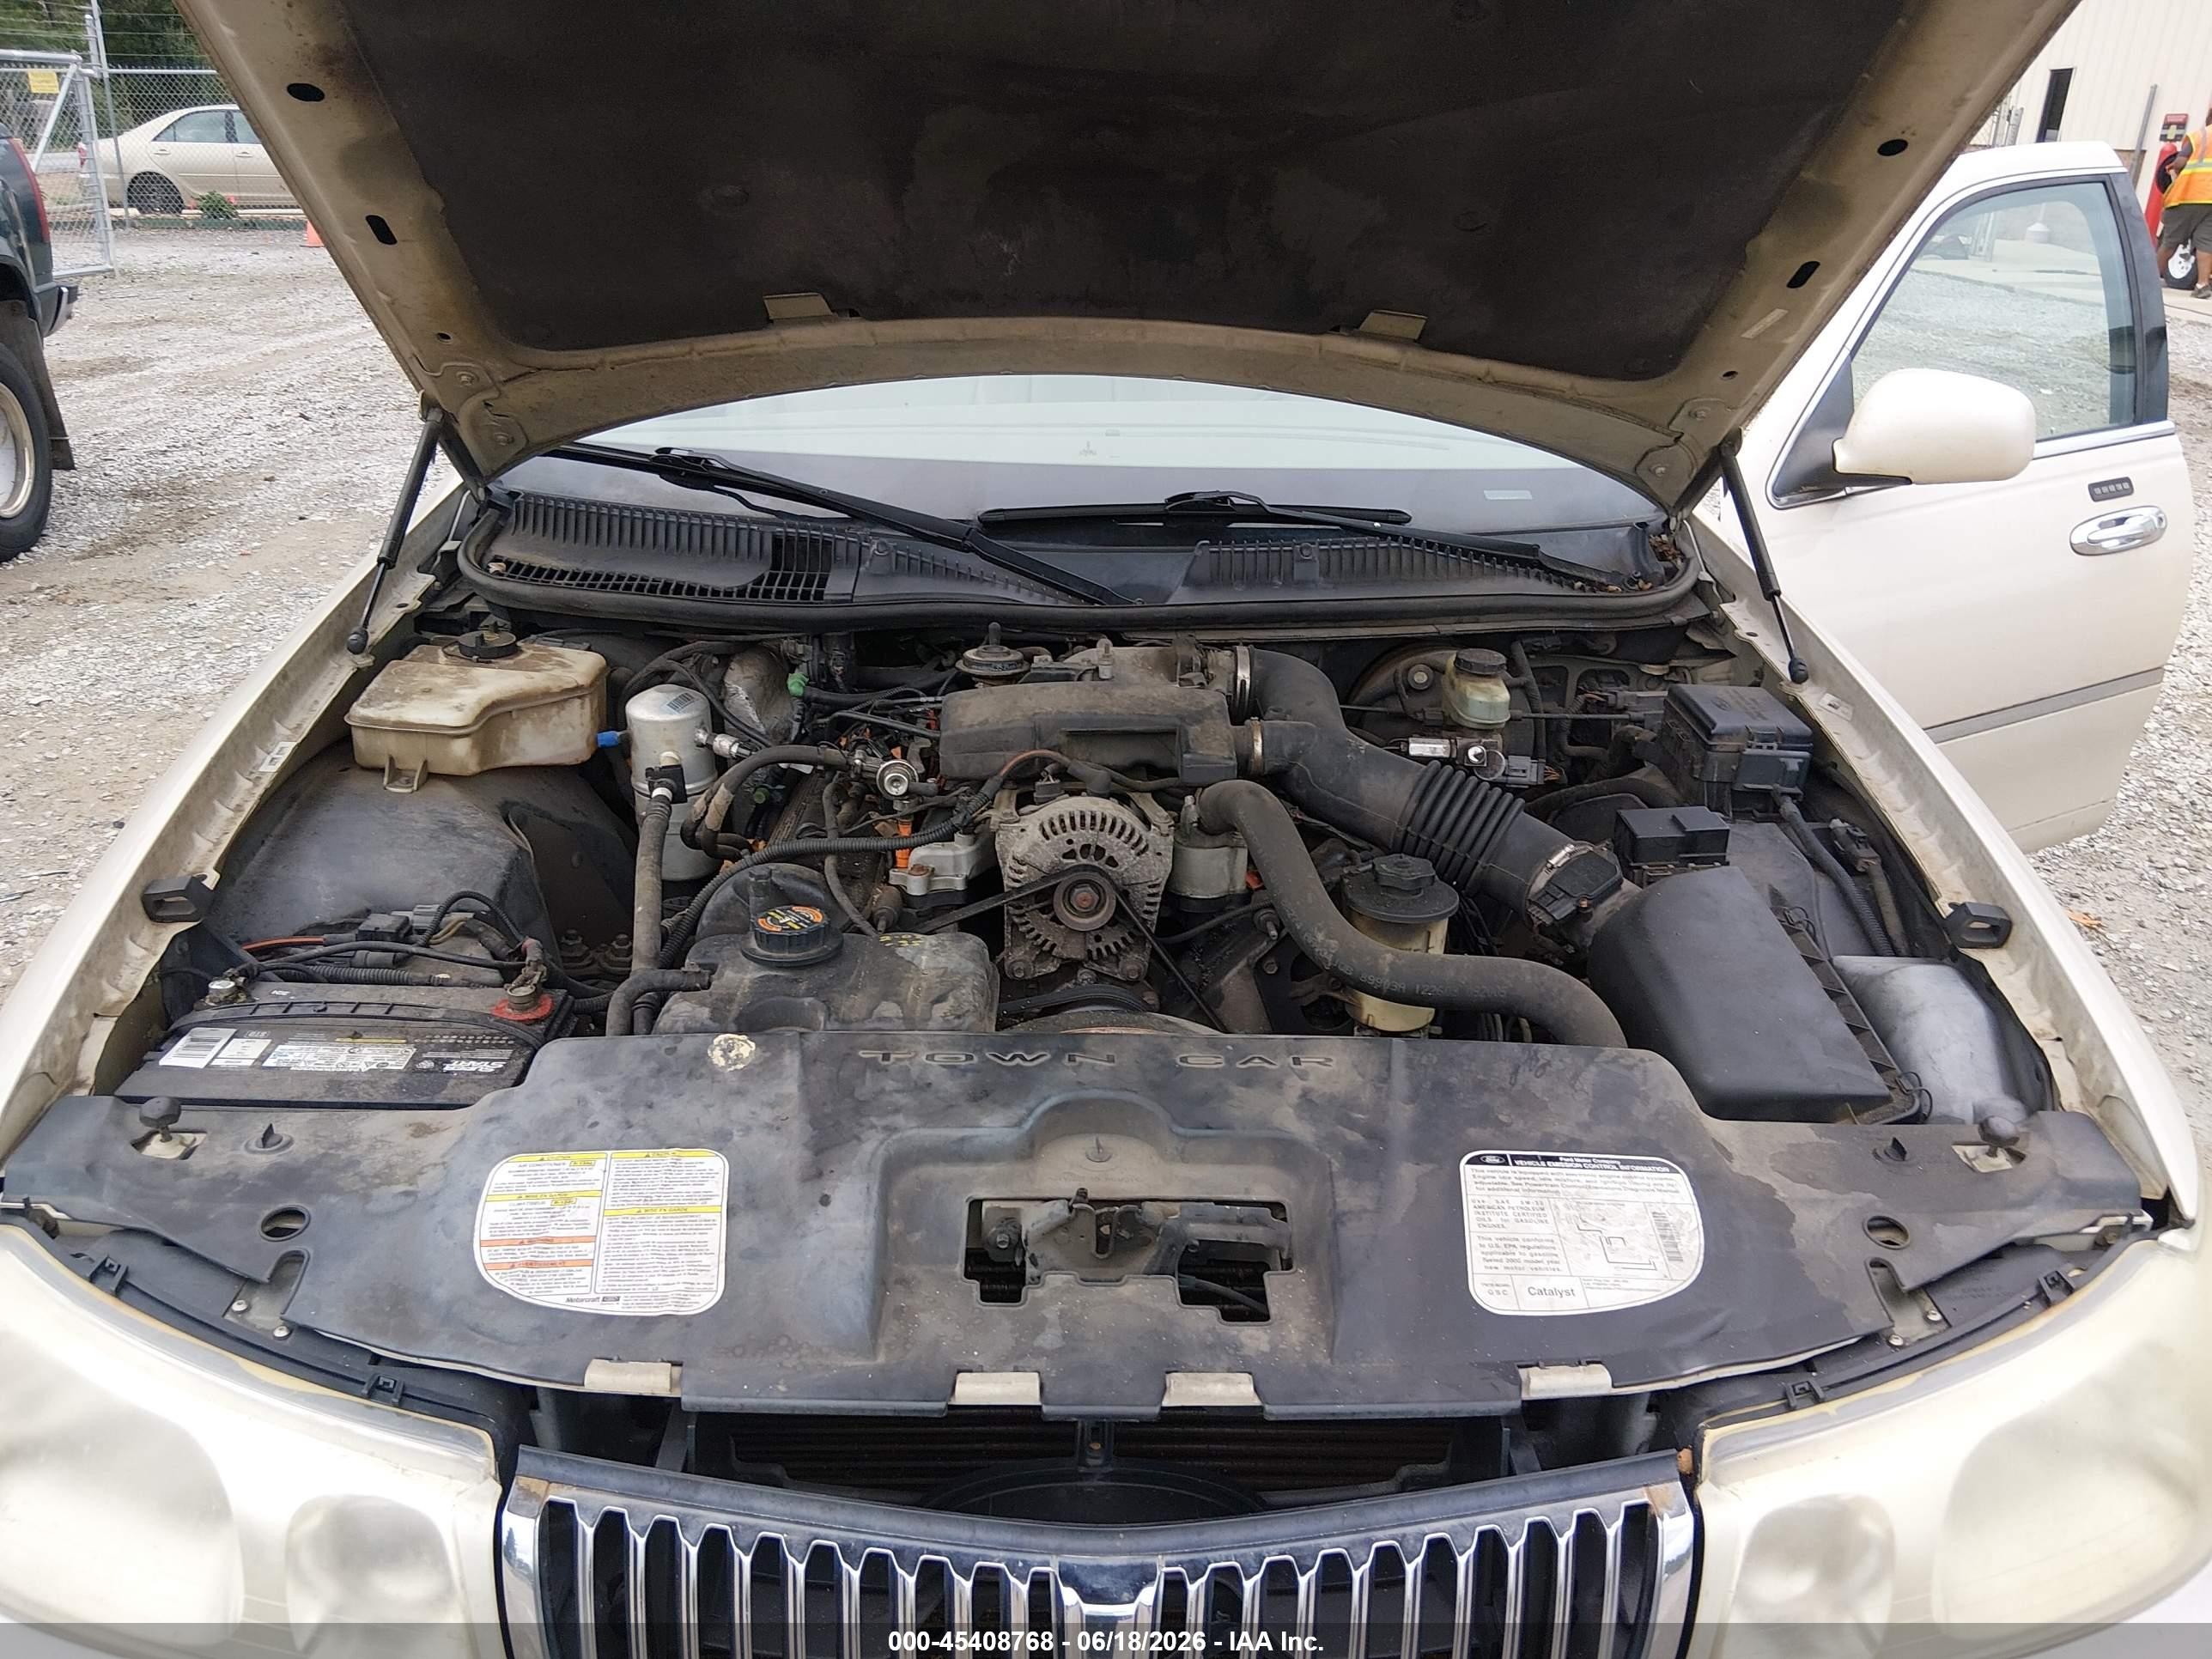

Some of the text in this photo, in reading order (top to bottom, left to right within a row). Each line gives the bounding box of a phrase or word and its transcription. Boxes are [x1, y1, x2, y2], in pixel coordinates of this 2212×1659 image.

[450, 1060, 507, 1068] START
[860, 1050, 1334, 1067] TOWN CAR
[1528, 1286, 1575, 1298] Catalyst
